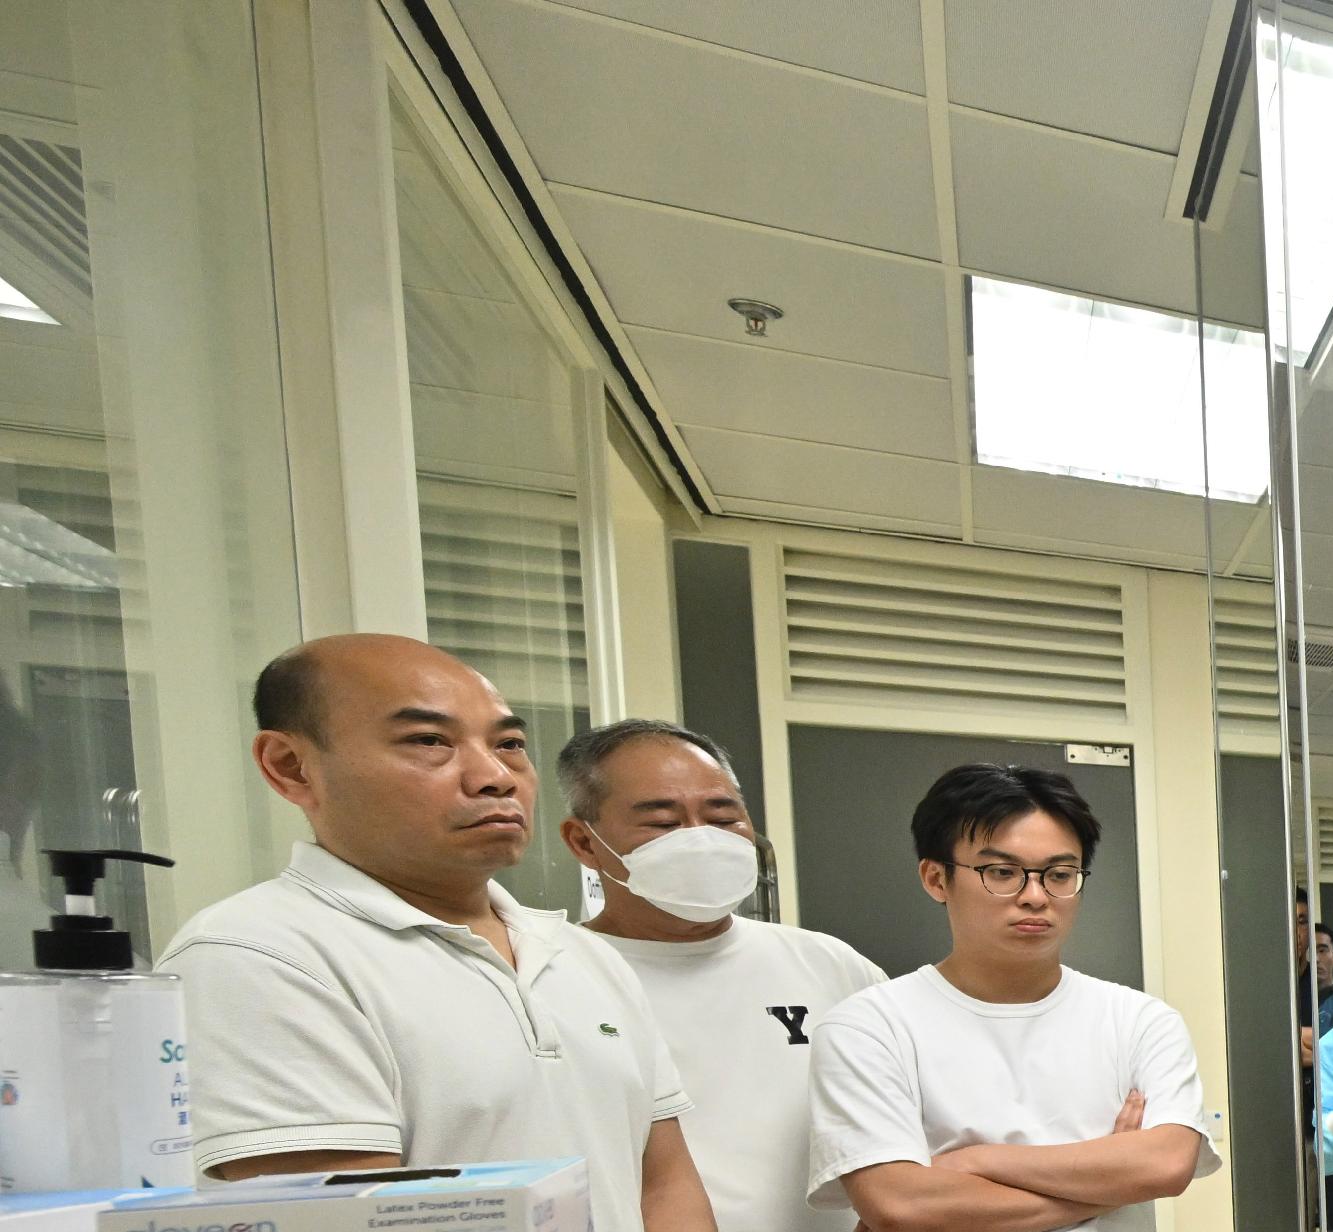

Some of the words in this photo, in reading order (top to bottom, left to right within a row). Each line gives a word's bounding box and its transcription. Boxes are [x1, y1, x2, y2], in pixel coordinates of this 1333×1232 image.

[765, 1005, 809, 1045] Y
[376, 1202, 414, 1215] Latex
[418, 1198, 471, 1212] Powder
[475, 1196, 505, 1208] Free
[368, 1212, 456, 1229] Examination
[459, 1209, 506, 1222] Gloves
